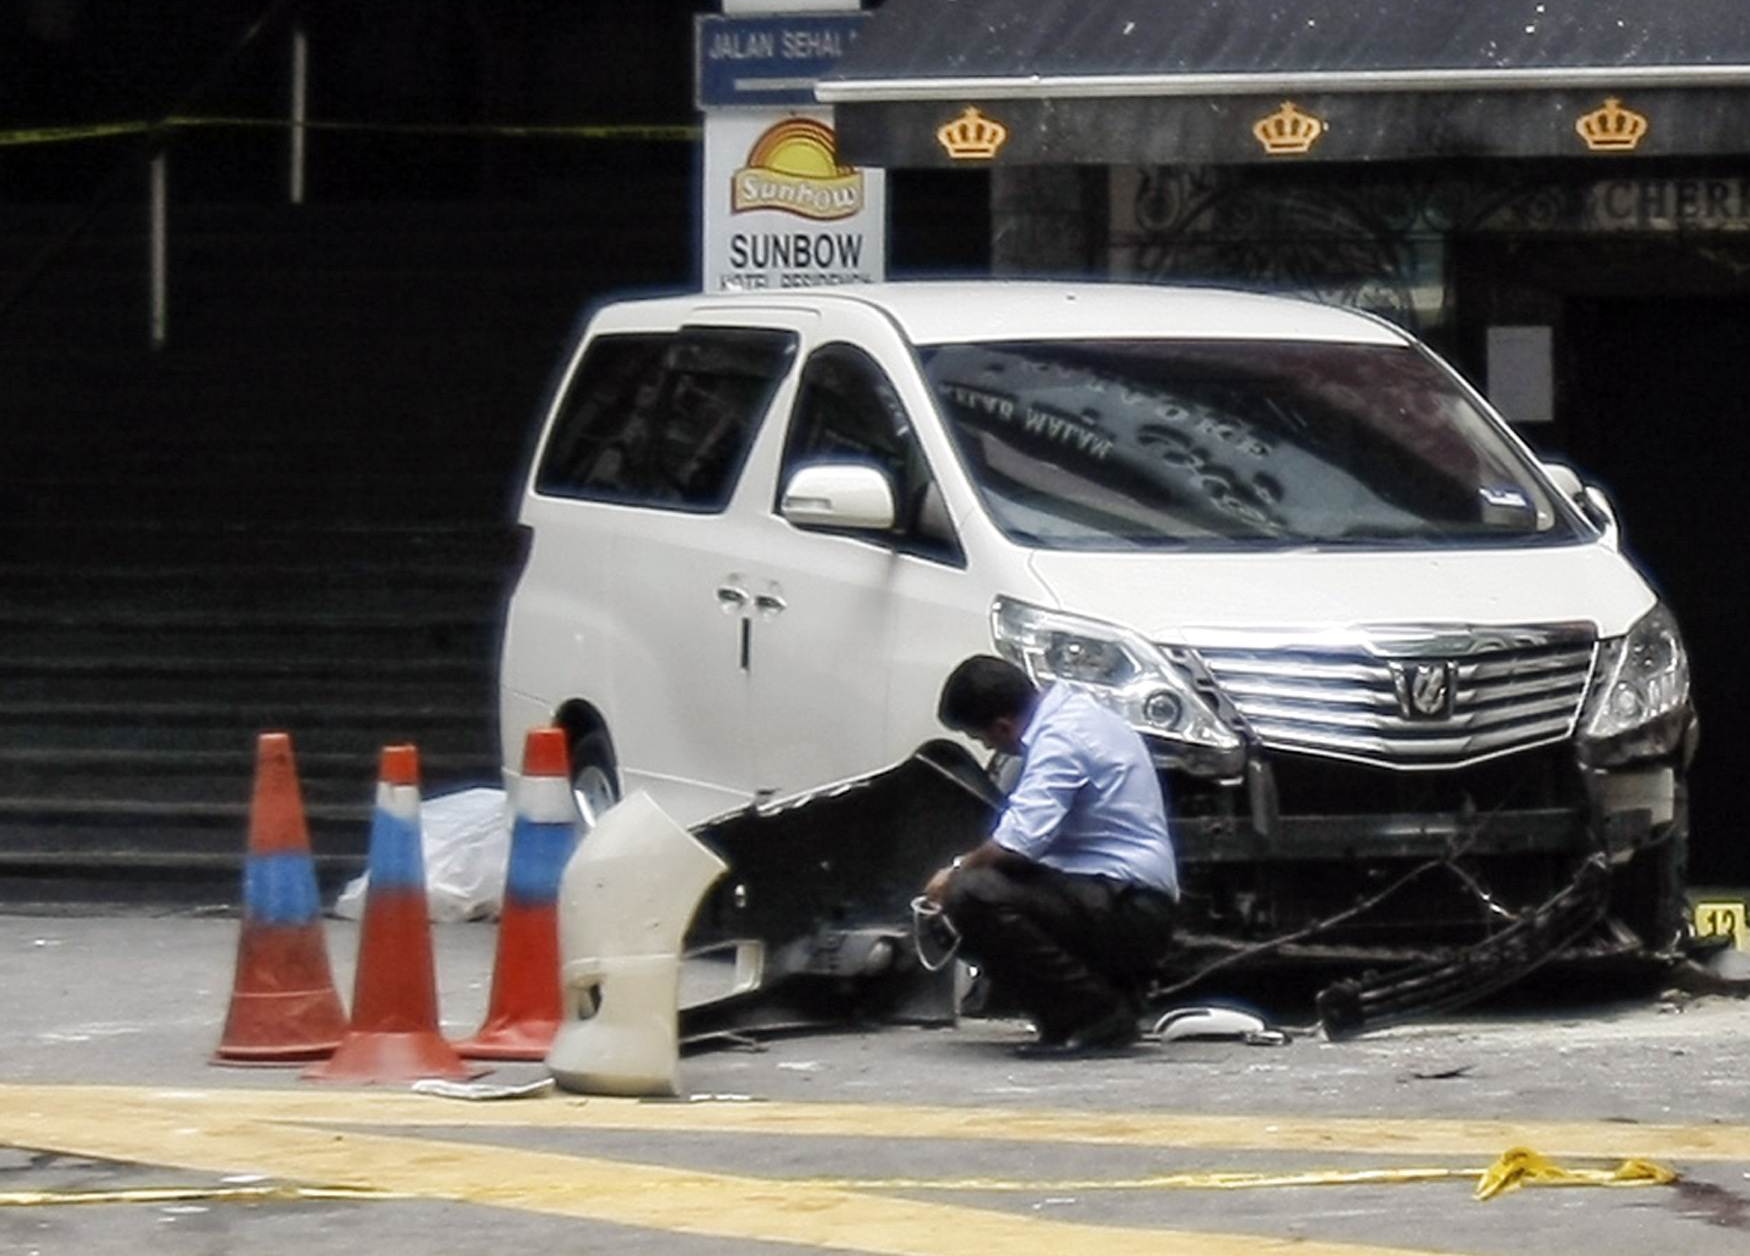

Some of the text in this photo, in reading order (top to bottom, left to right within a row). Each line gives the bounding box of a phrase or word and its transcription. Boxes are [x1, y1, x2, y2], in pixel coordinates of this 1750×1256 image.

[709, 31, 774, 60] JALAN
[743, 173, 857, 211] Sunbow
[730, 233, 864, 269] SUNBOW
